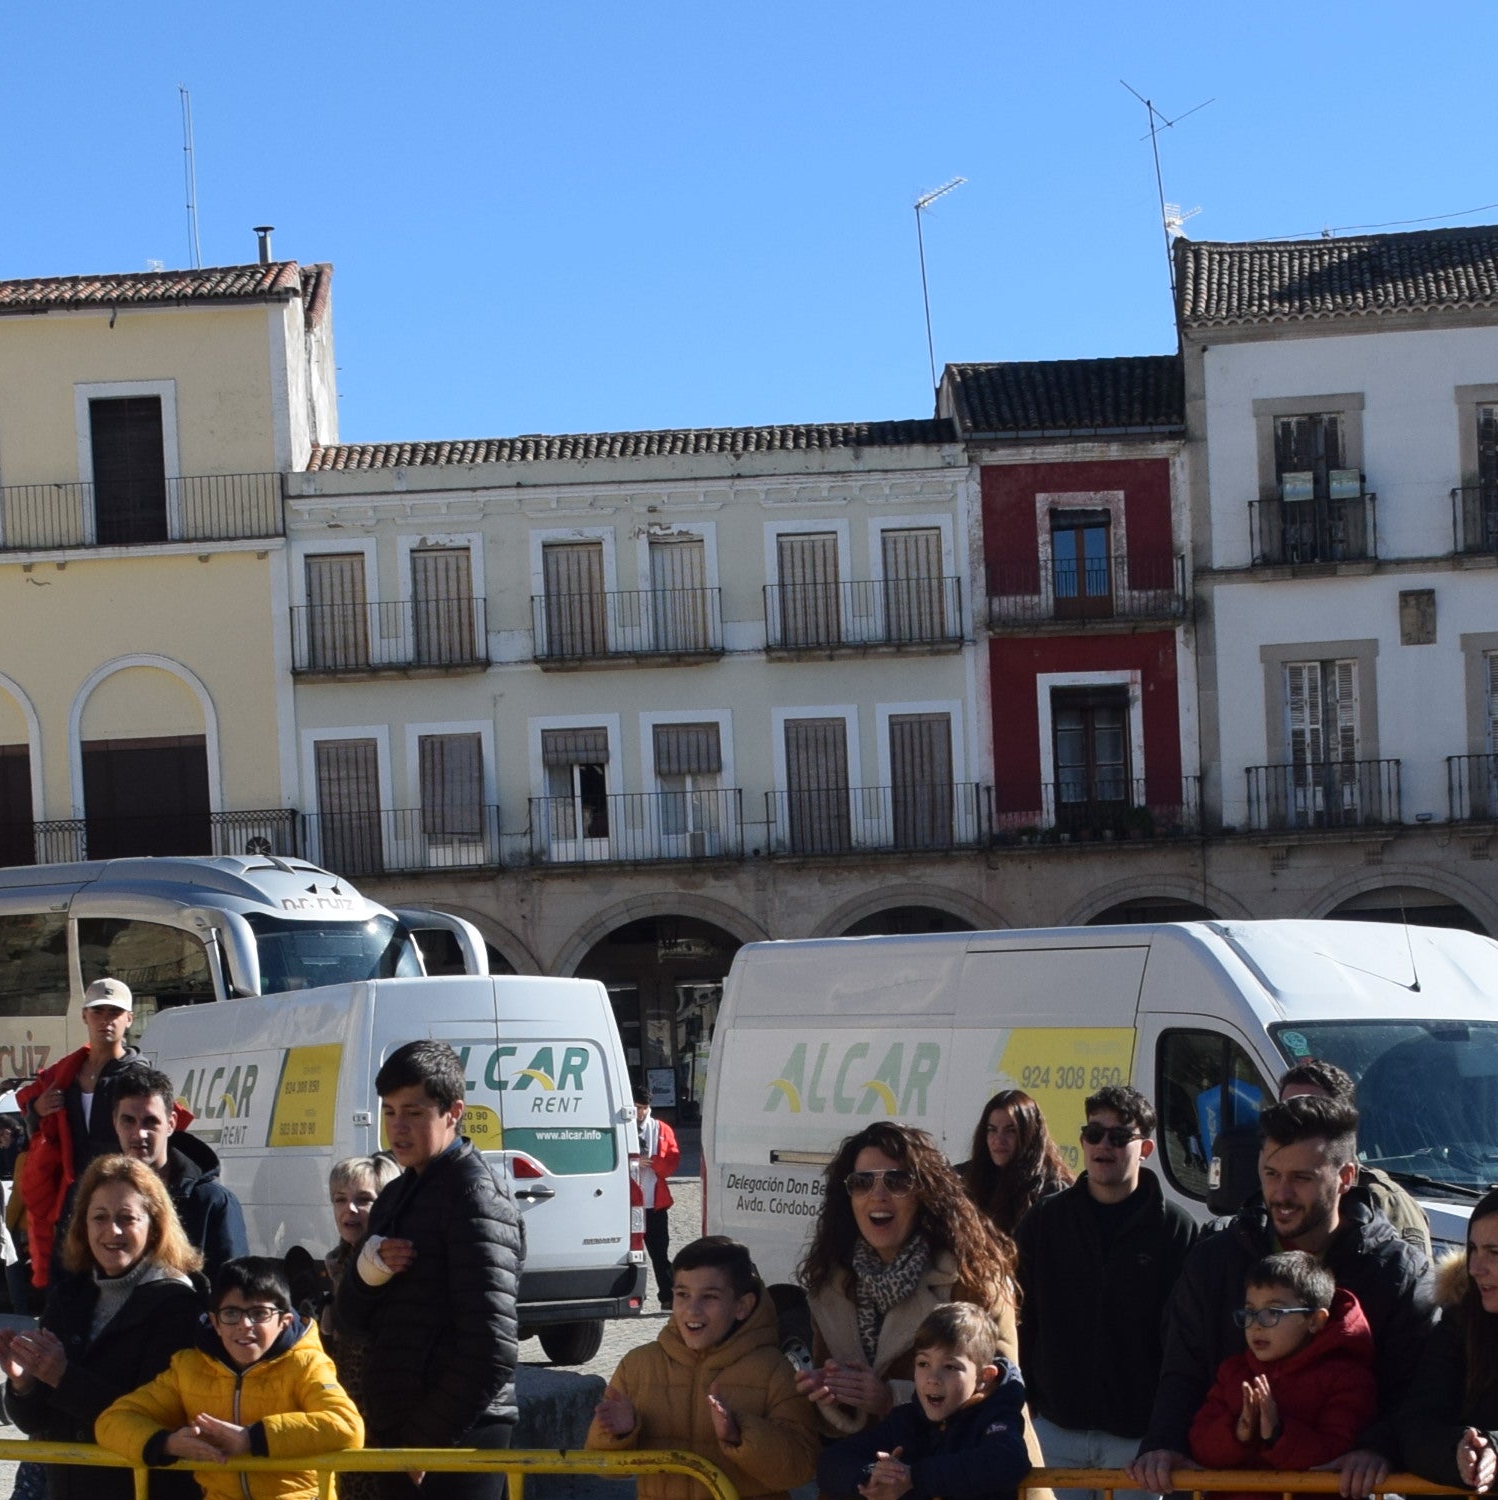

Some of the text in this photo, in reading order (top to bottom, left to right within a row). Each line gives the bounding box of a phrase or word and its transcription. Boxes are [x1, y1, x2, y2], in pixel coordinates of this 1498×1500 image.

[462, 1046, 589, 1091] LCAR
[1022, 1066, 1120, 1089] 924 308 850
[763, 1042, 941, 1116] ALCAR
[176, 1064, 259, 1120] ALCAR
[531, 1097, 582, 1113] RENT
[476, 1112, 488, 1121] 90
[221, 1126, 248, 1145] RENT
[470, 1125, 488, 1134] 850
[536, 1130, 602, 1140] www.alcar.info
[727, 1174, 784, 1194] Delegación
[787, 1178, 808, 1194] Don
[736, 1198, 766, 1212] Avda.
